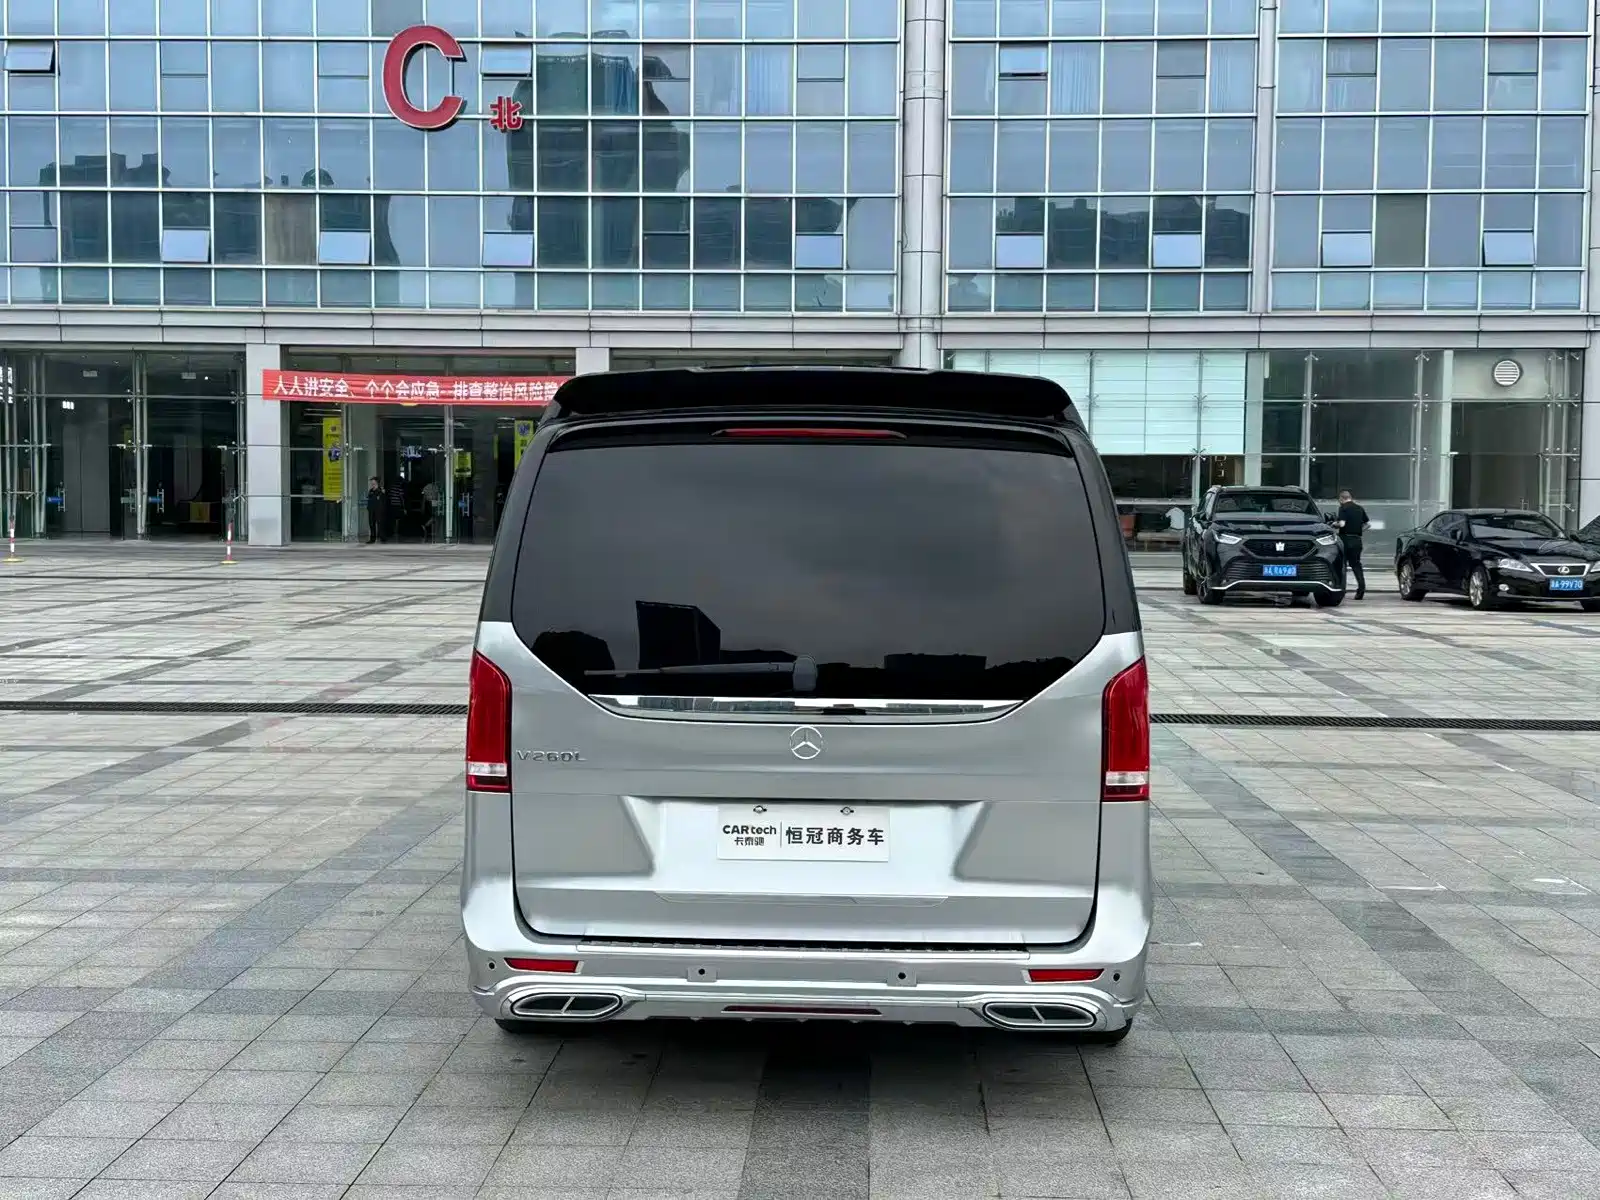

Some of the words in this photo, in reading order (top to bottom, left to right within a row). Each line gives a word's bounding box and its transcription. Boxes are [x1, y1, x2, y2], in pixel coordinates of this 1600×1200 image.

[382, 24, 464, 128] C
[489, 95, 523, 130] 北
[515, 749, 586, 763] V260L
[785, 826, 885, 846] 恒冠商务车
